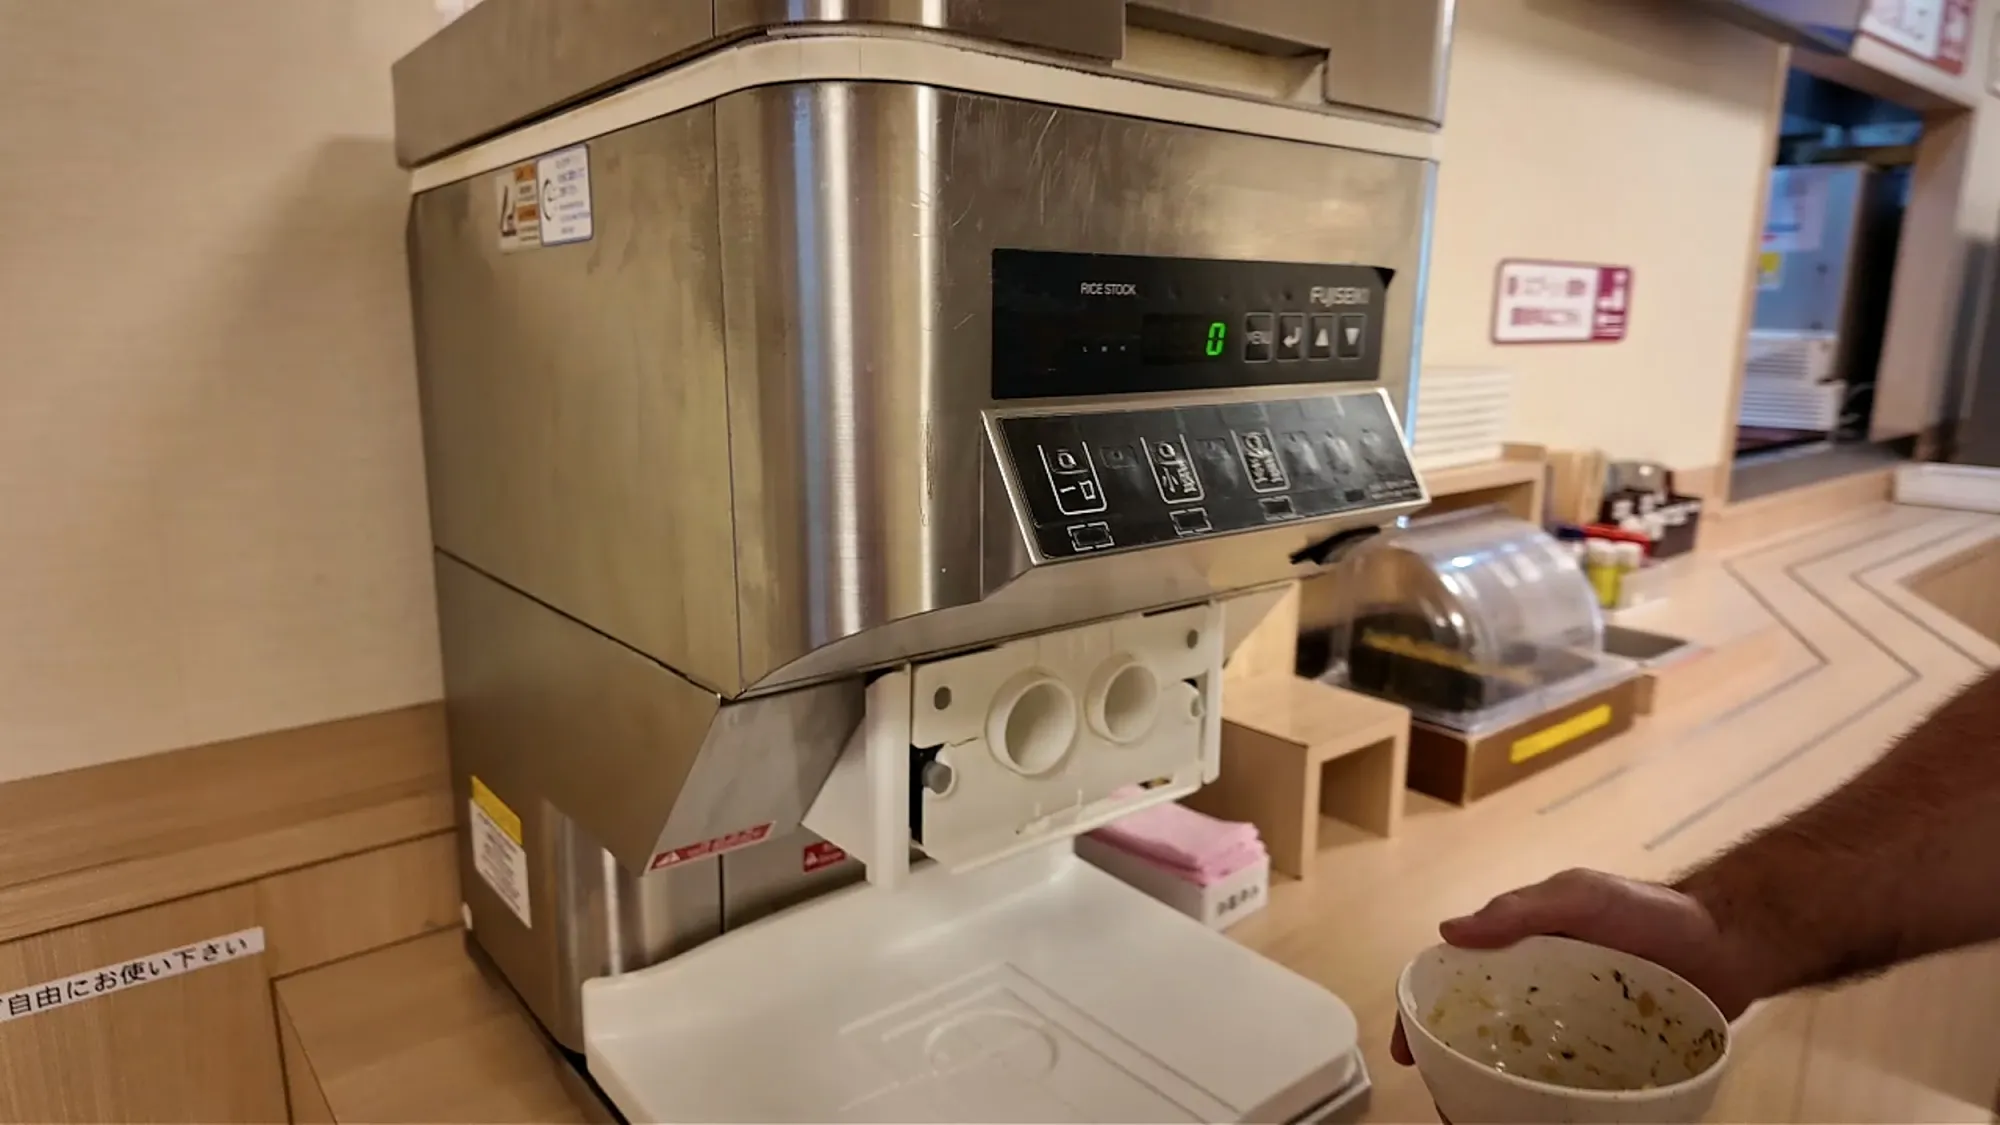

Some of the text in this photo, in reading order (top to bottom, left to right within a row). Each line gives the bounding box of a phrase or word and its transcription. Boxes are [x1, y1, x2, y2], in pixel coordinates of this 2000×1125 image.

[1080, 282, 1136, 295] RICE STOCK
[1206, 322, 1226, 356] 0
[0, 937, 248, 1017] 自由にお使い下さい
